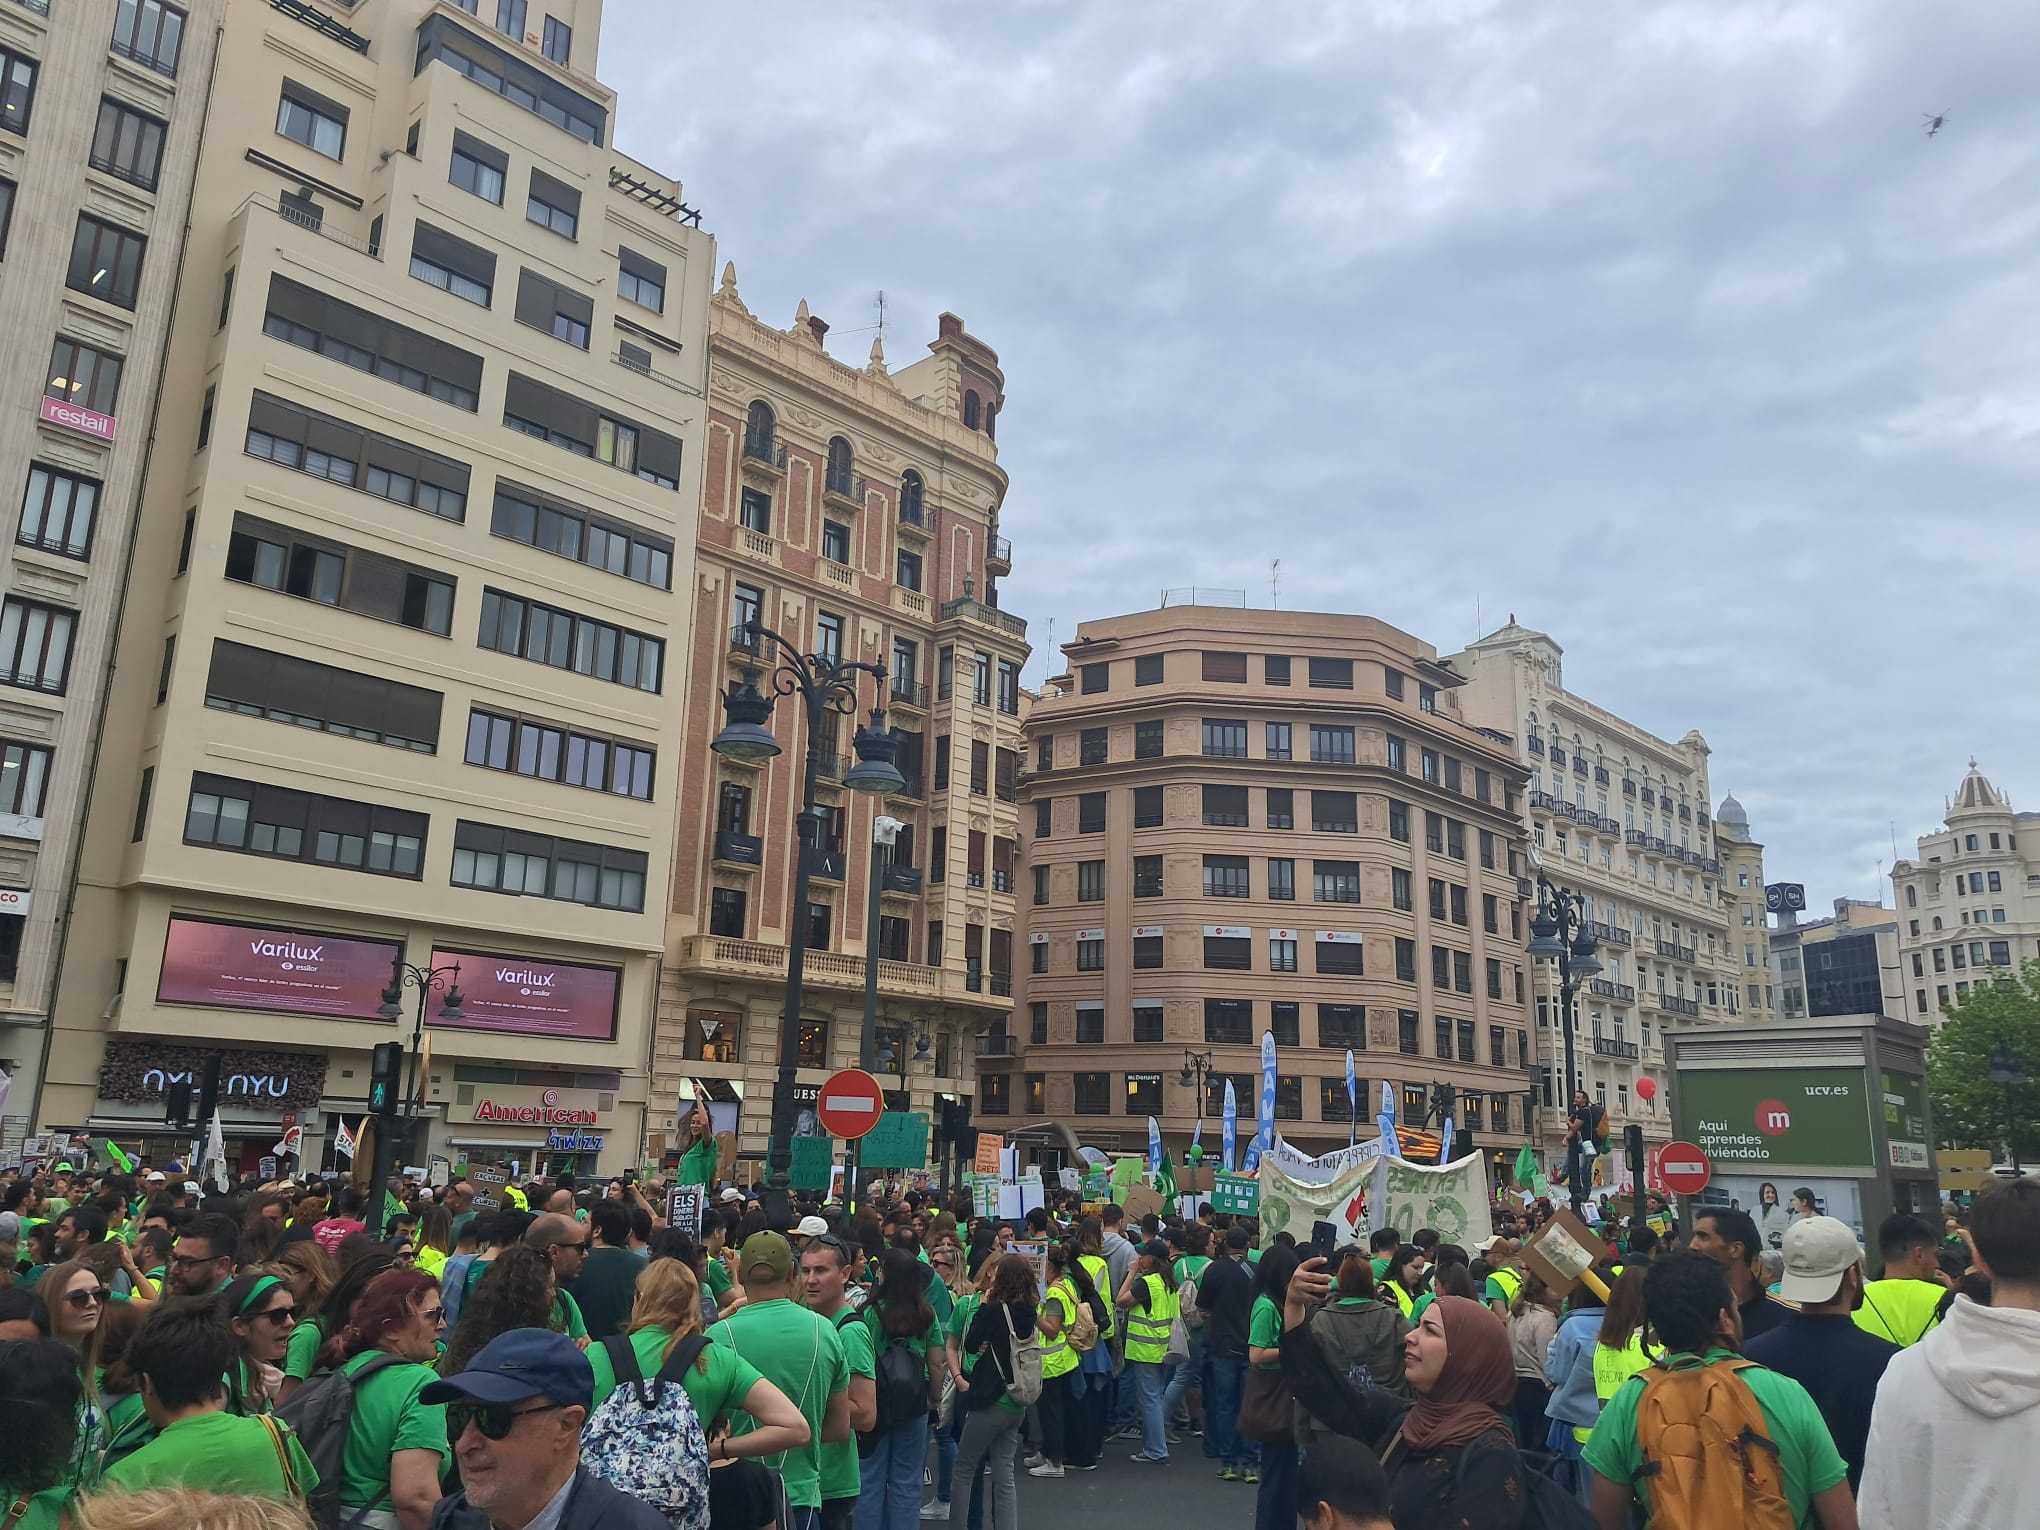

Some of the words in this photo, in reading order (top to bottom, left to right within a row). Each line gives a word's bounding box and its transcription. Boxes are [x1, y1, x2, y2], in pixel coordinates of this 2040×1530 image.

[50, 405, 108, 433] restail
[251, 939, 324, 961] Varilux
[296, 964, 318, 973] essilor
[496, 967, 555, 987] Varilux
[1805, 1085, 1849, 1096] ucv.es
[475, 1099, 599, 1125] American
[1698, 1119, 1728, 1134] Aquí
[1699, 1133, 1762, 1149] aprendes
[673, 1194, 696, 1208] ELS
